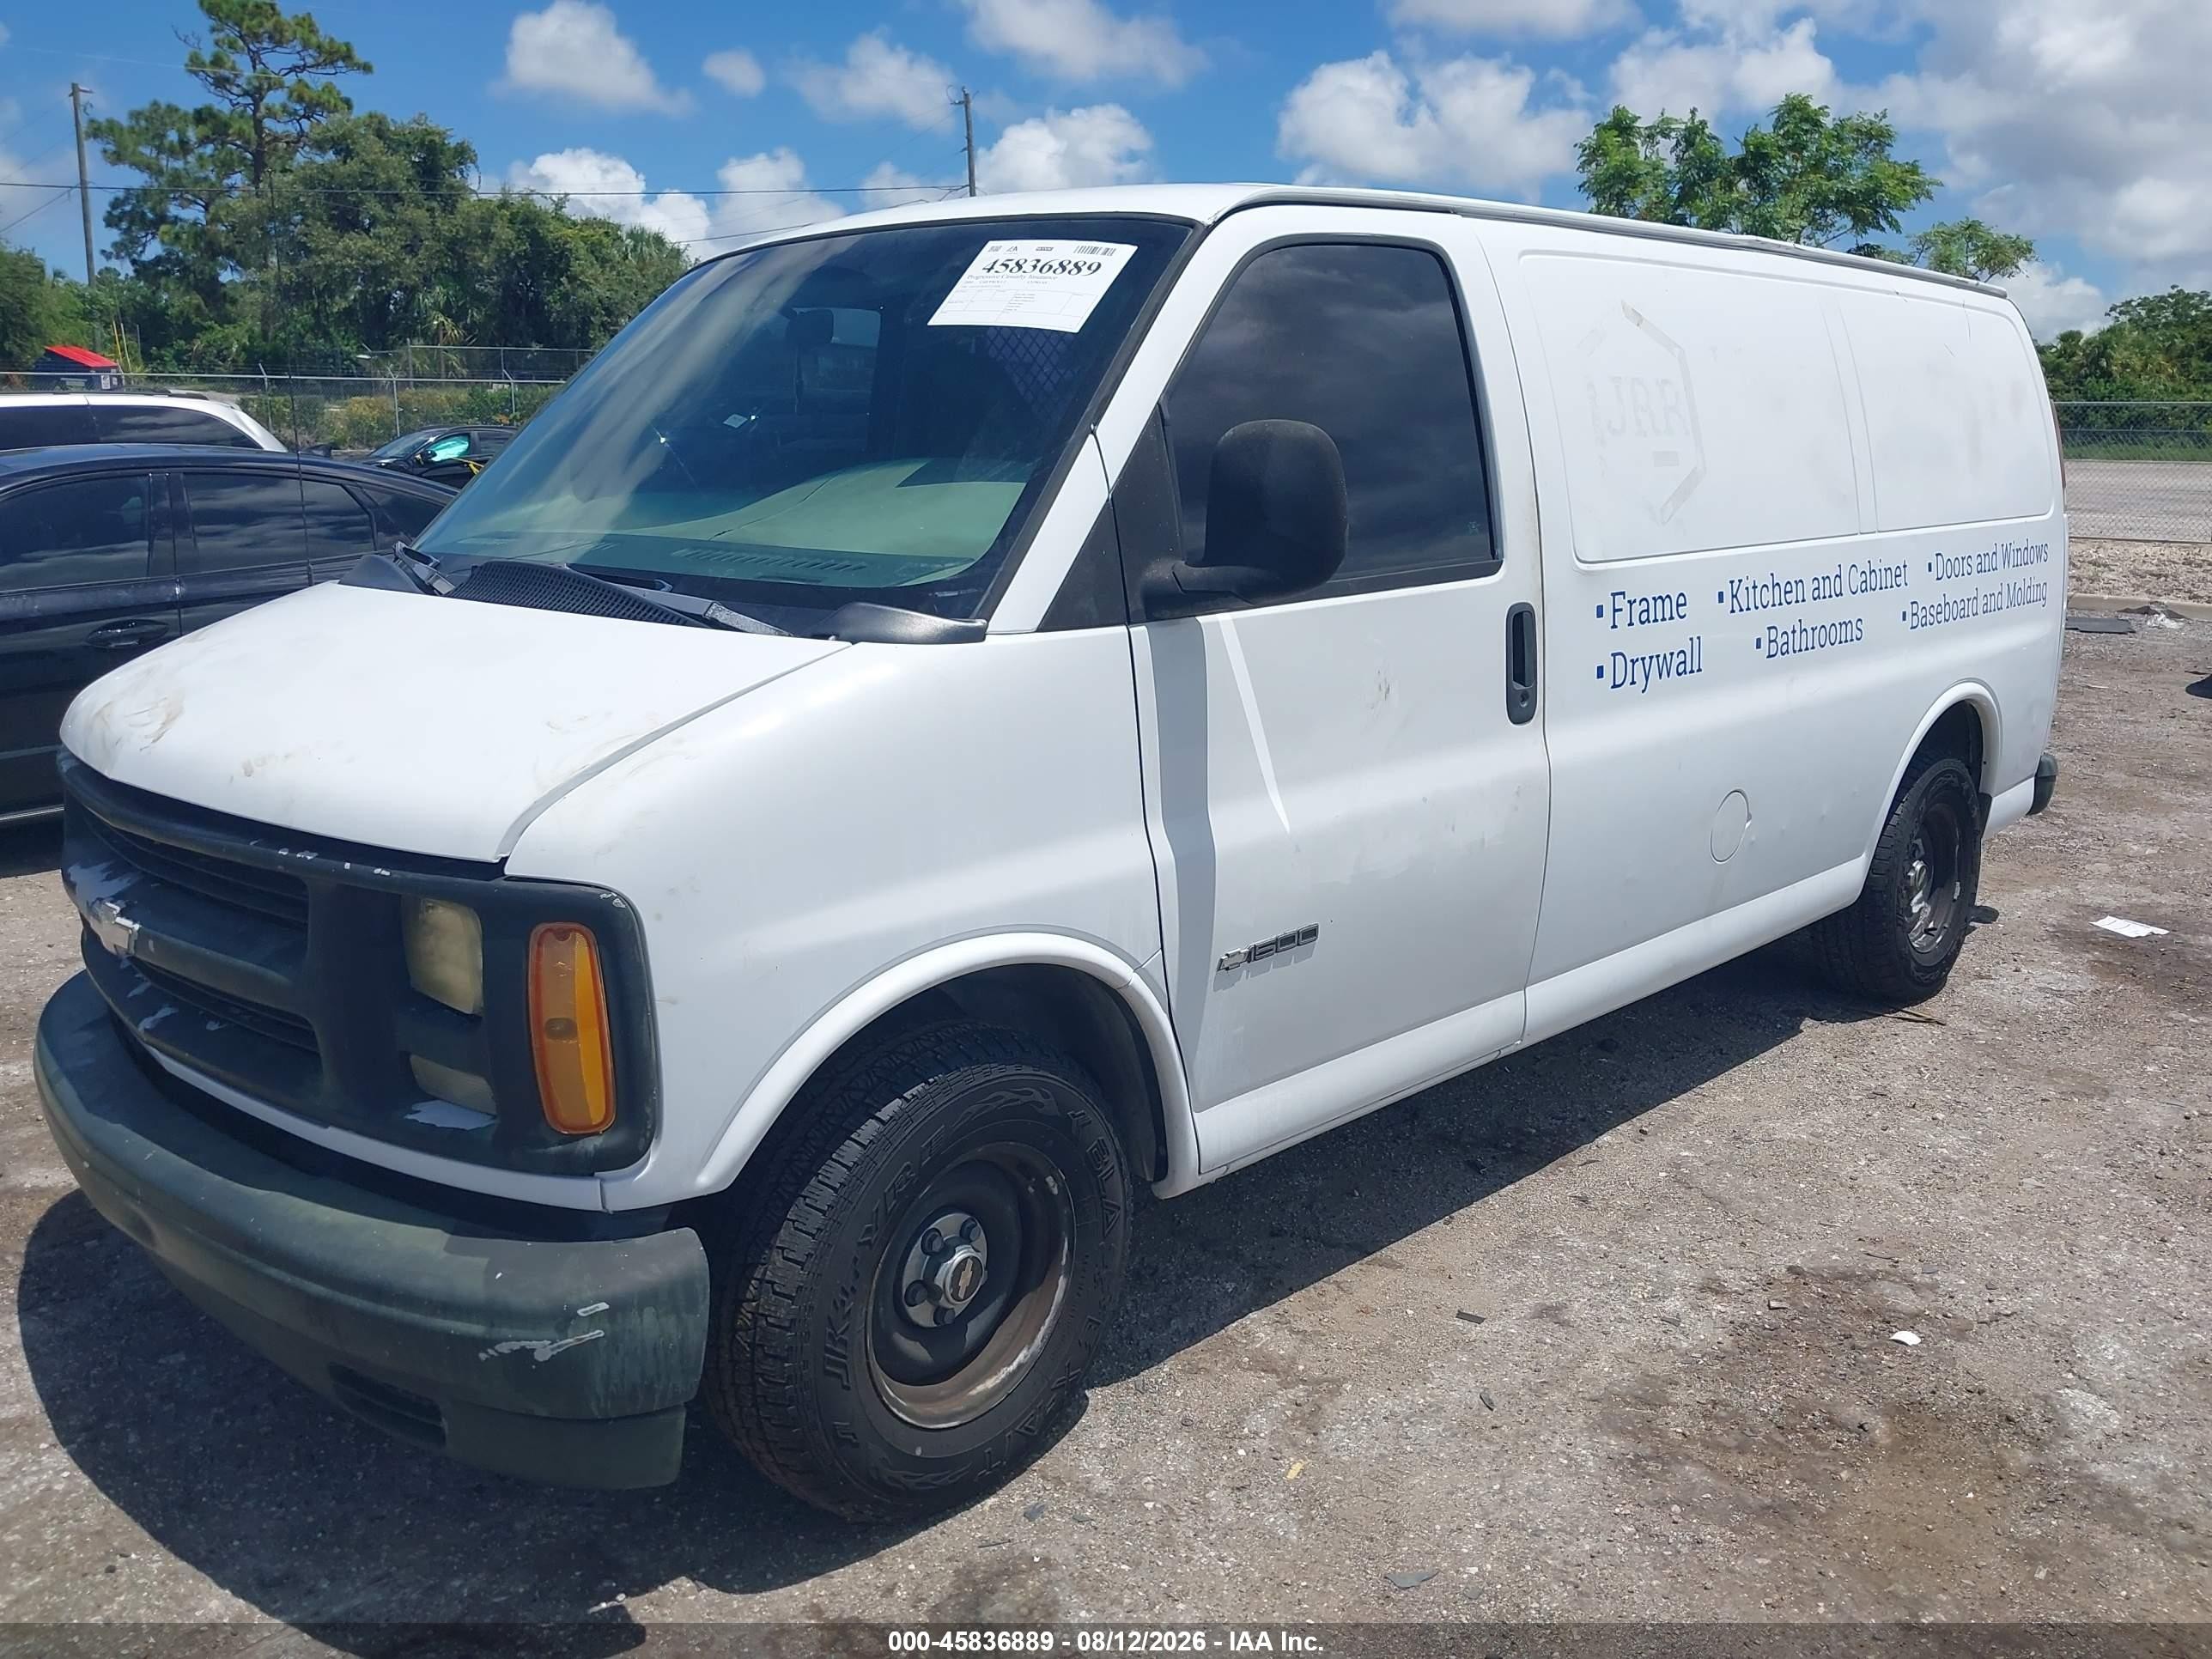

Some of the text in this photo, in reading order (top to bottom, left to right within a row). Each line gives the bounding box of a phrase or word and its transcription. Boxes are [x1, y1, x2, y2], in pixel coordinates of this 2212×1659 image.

[981, 258, 1103, 276] 45836889
[1936, 538, 2049, 580] Doors and Windows
[1729, 558, 1908, 614] Kitchen and Cabinet
[1910, 576, 2048, 630] Baseboard and Molding
[1610, 590, 1687, 629] Frame
[1765, 618, 1863, 659] Bathrooms
[1610, 635, 1703, 694] Drywall
[1247, 922, 1319, 963] 1500
